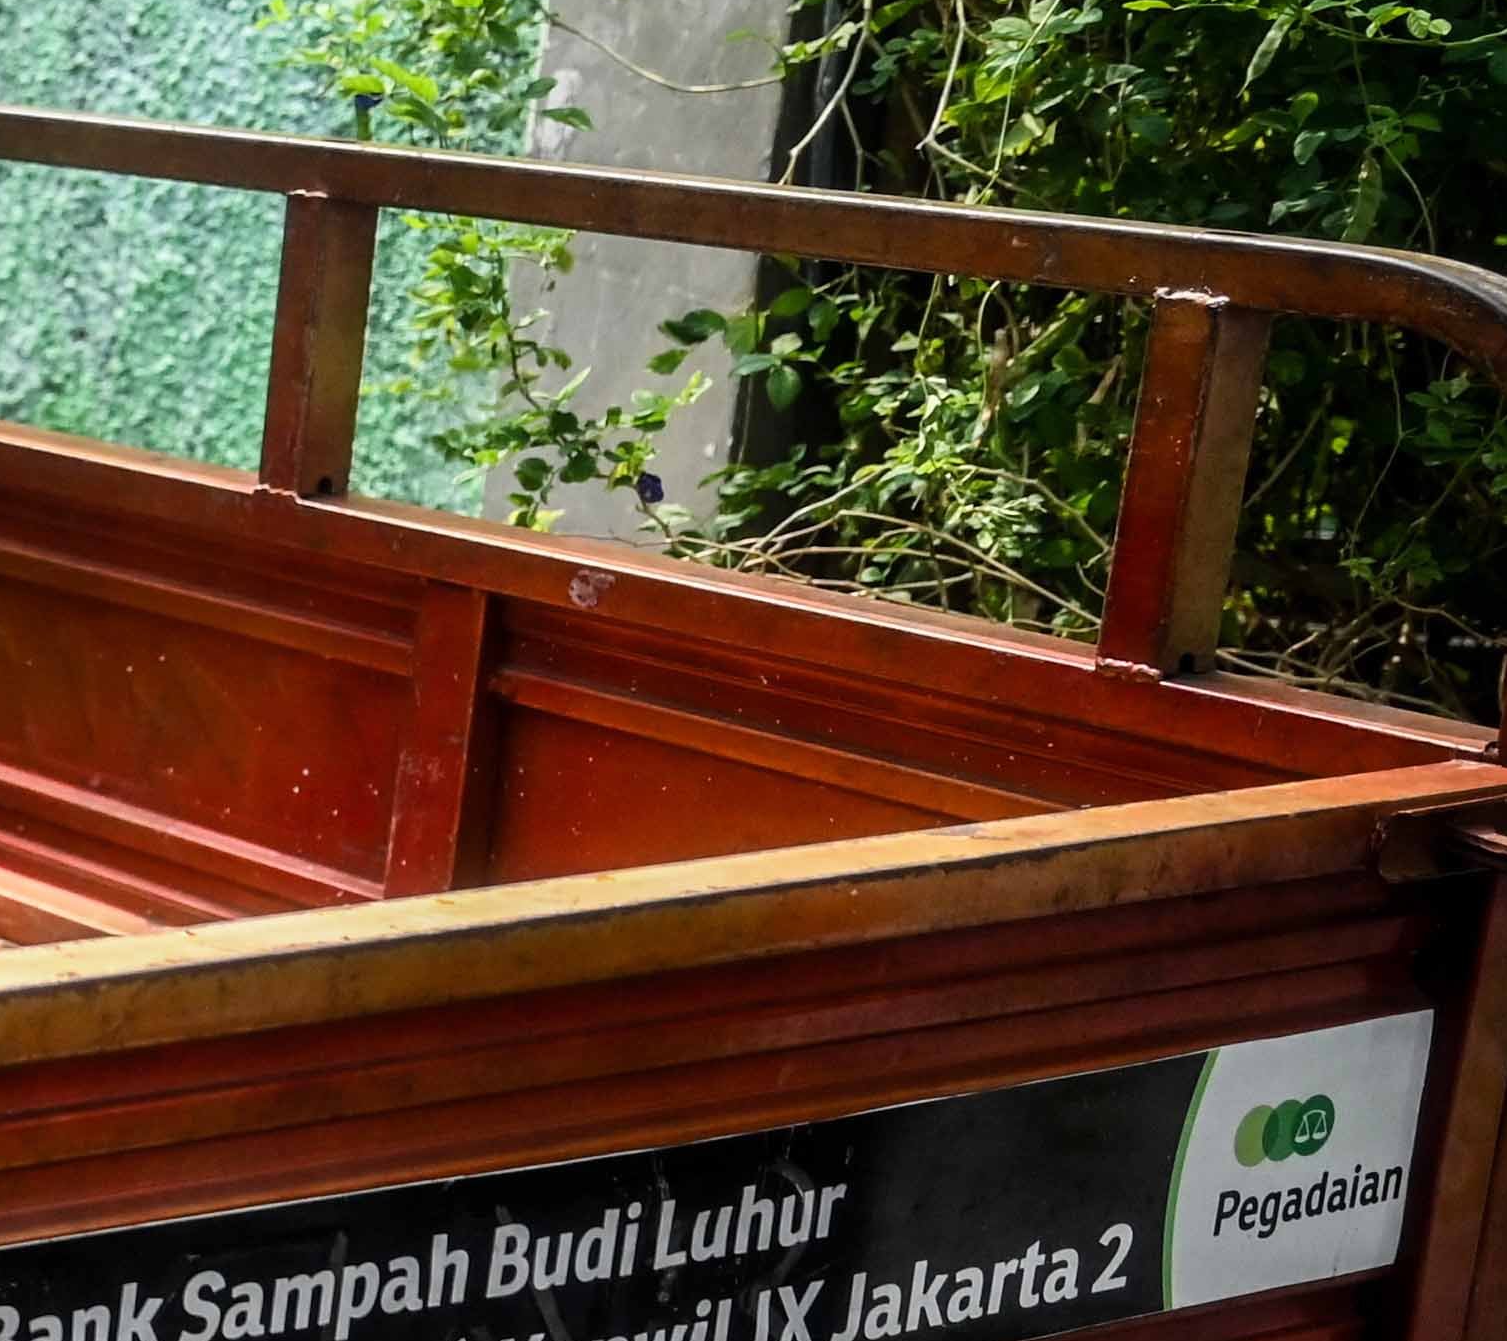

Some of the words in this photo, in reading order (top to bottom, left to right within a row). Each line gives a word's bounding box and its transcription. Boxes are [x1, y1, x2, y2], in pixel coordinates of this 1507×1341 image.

[1213, 1164, 1403, 1239] Pegadaian
[485, 1201, 642, 1299] Budi
[652, 1182, 847, 1270] Luhur
[1091, 1221, 1134, 1293] 2
